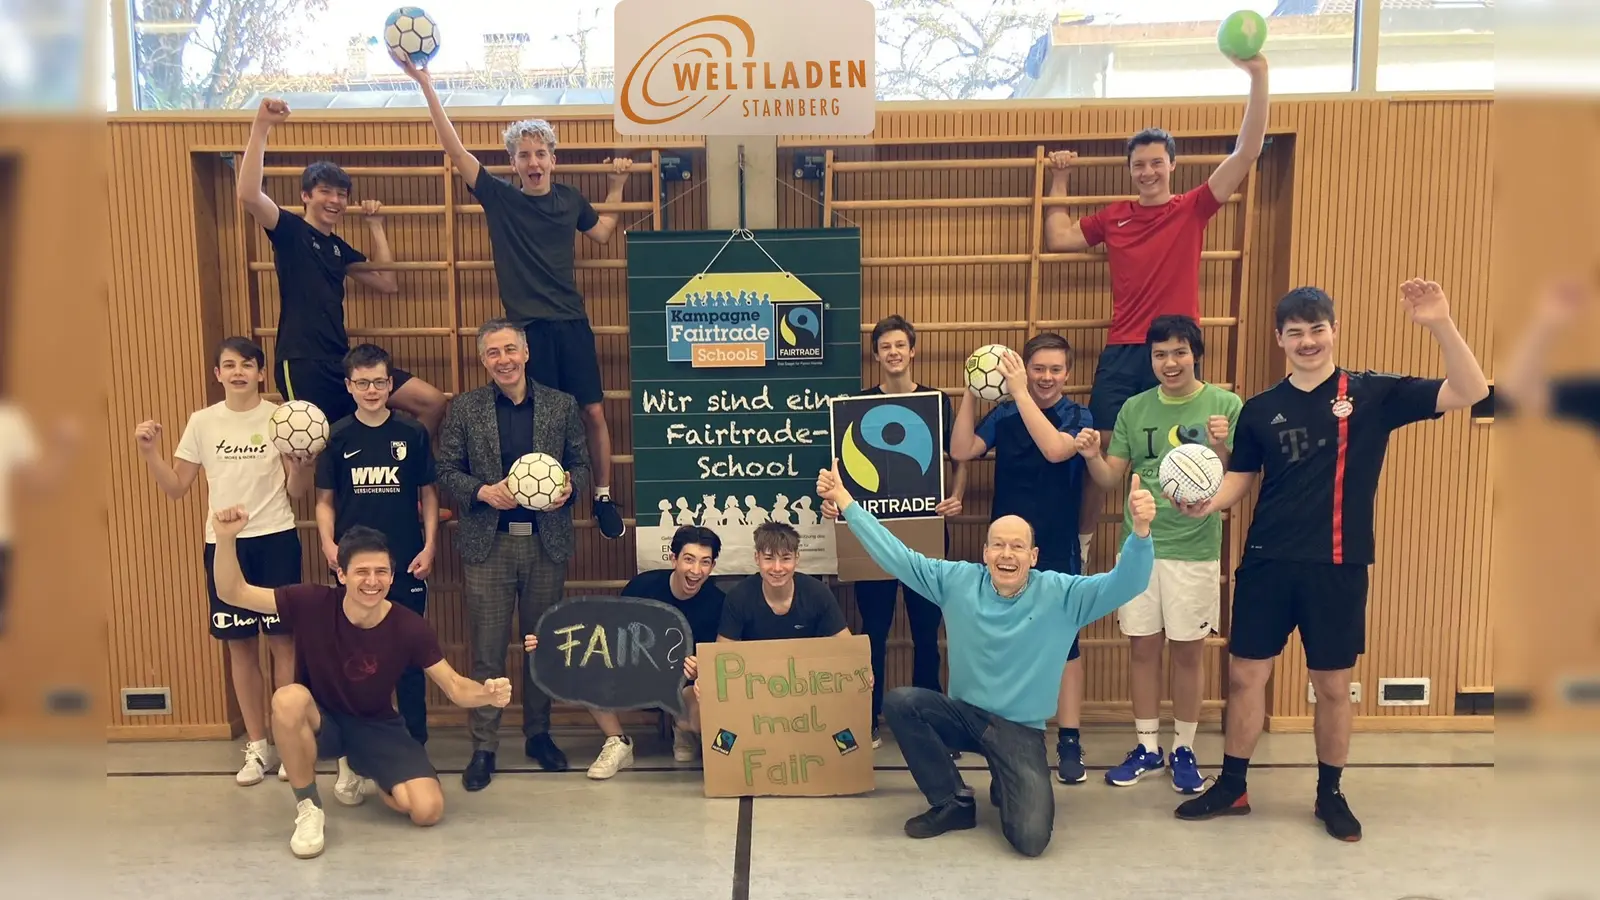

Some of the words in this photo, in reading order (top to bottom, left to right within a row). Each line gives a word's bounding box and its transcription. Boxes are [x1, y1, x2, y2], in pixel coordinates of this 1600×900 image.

[671, 309, 761, 325] Kampagne
[671, 324, 770, 342] Fairtrade
[697, 348, 759, 362] Schools
[779, 348, 820, 357] FAIRTRADE
[642, 388, 693, 413] Wir
[707, 384, 774, 412] sind
[666, 417, 829, 446] Fairtrade-
[215, 439, 268, 454] tennis
[1142, 427, 1158, 459] I
[351, 466, 400, 485] WWK
[697, 453, 799, 480] School
[861, 496, 936, 515] IRTRADE
[212, 612, 281, 630] Chapi
[752, 705, 827, 736] mal
[742, 748, 826, 787] Fair
